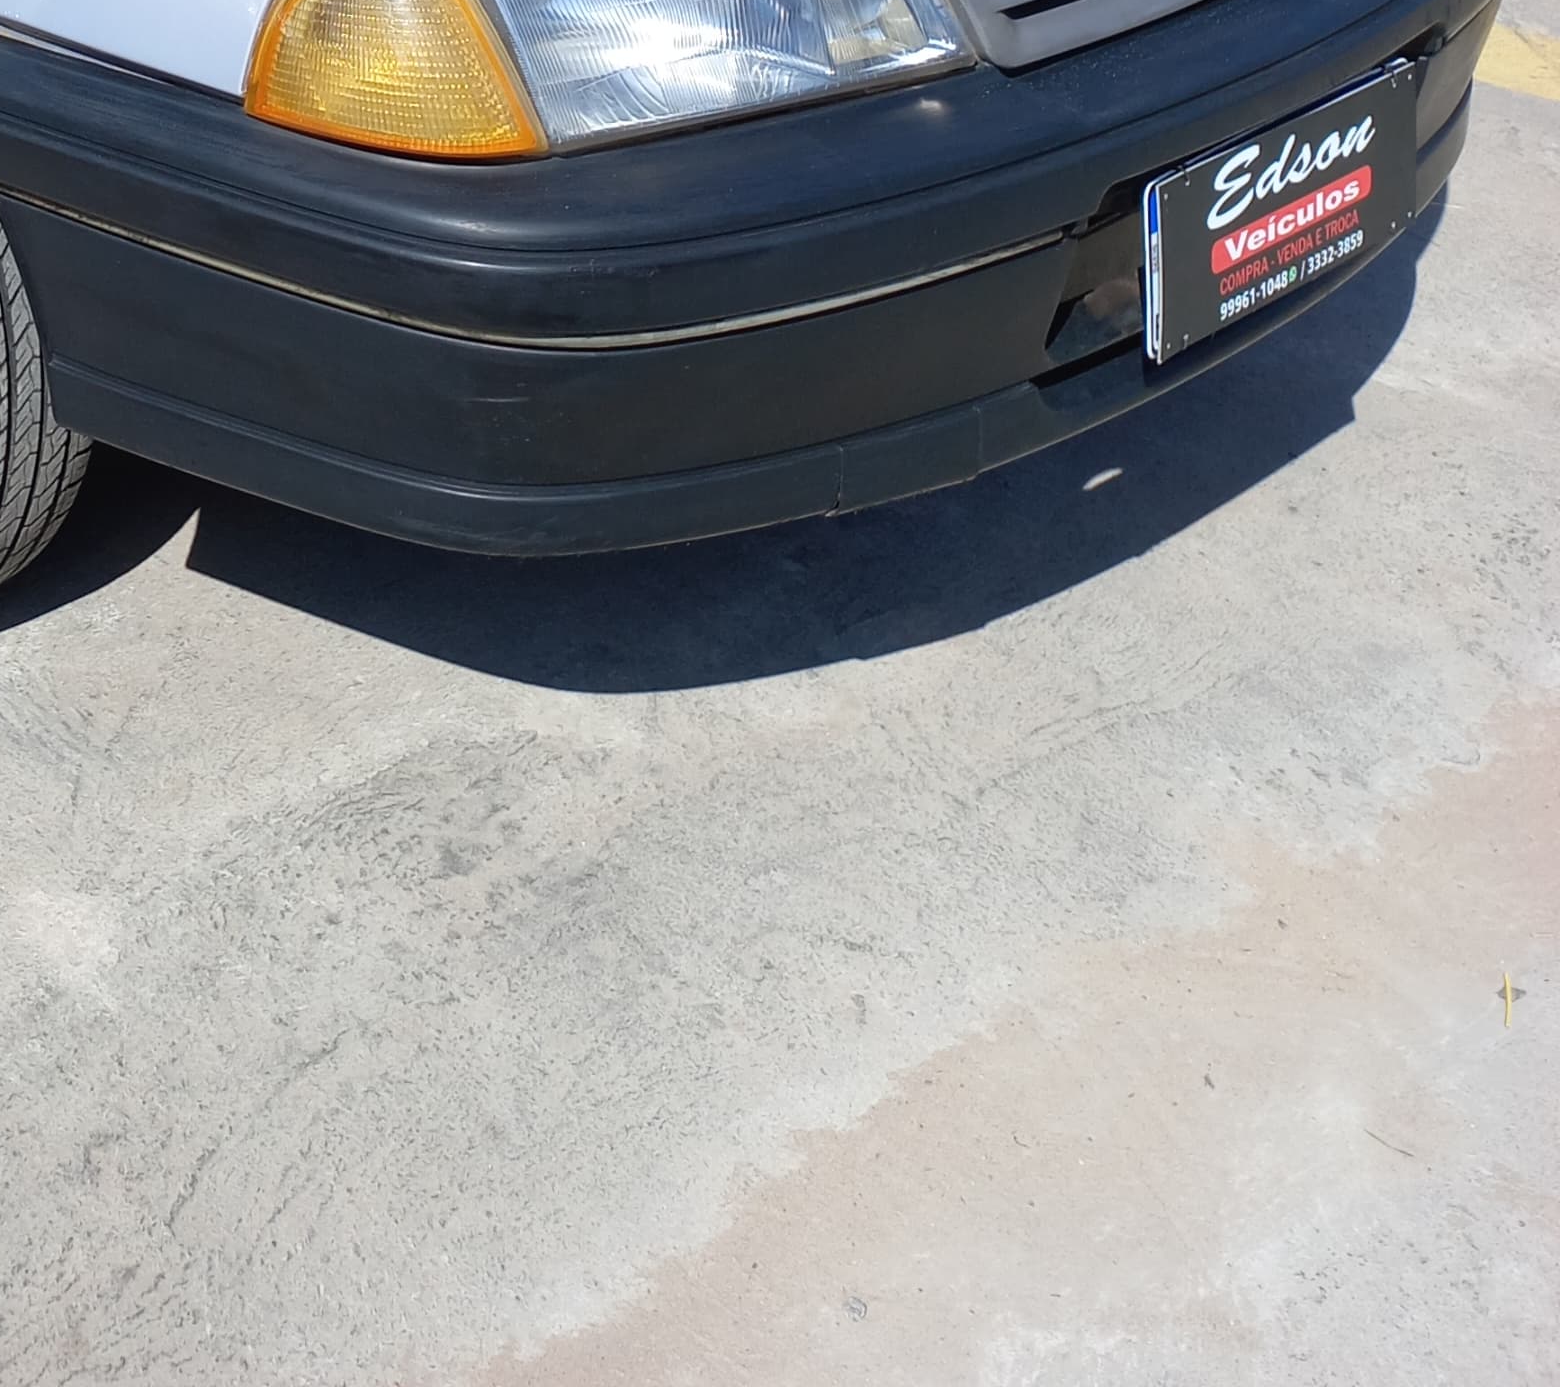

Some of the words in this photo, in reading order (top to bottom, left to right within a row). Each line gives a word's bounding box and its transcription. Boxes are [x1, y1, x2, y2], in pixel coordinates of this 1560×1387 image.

[1206, 115, 1376, 231] Edson
[1219, 258, 1269, 296] COMPRA
[1276, 239, 1313, 265] VENDA
[1315, 230, 1322, 247] E
[1324, 209, 1360, 240] TROCA
[1223, 178, 1361, 261] Veículos
[1219, 269, 1289, 322] 99961-1048
[1306, 229, 1364, 276] 3332-3859
